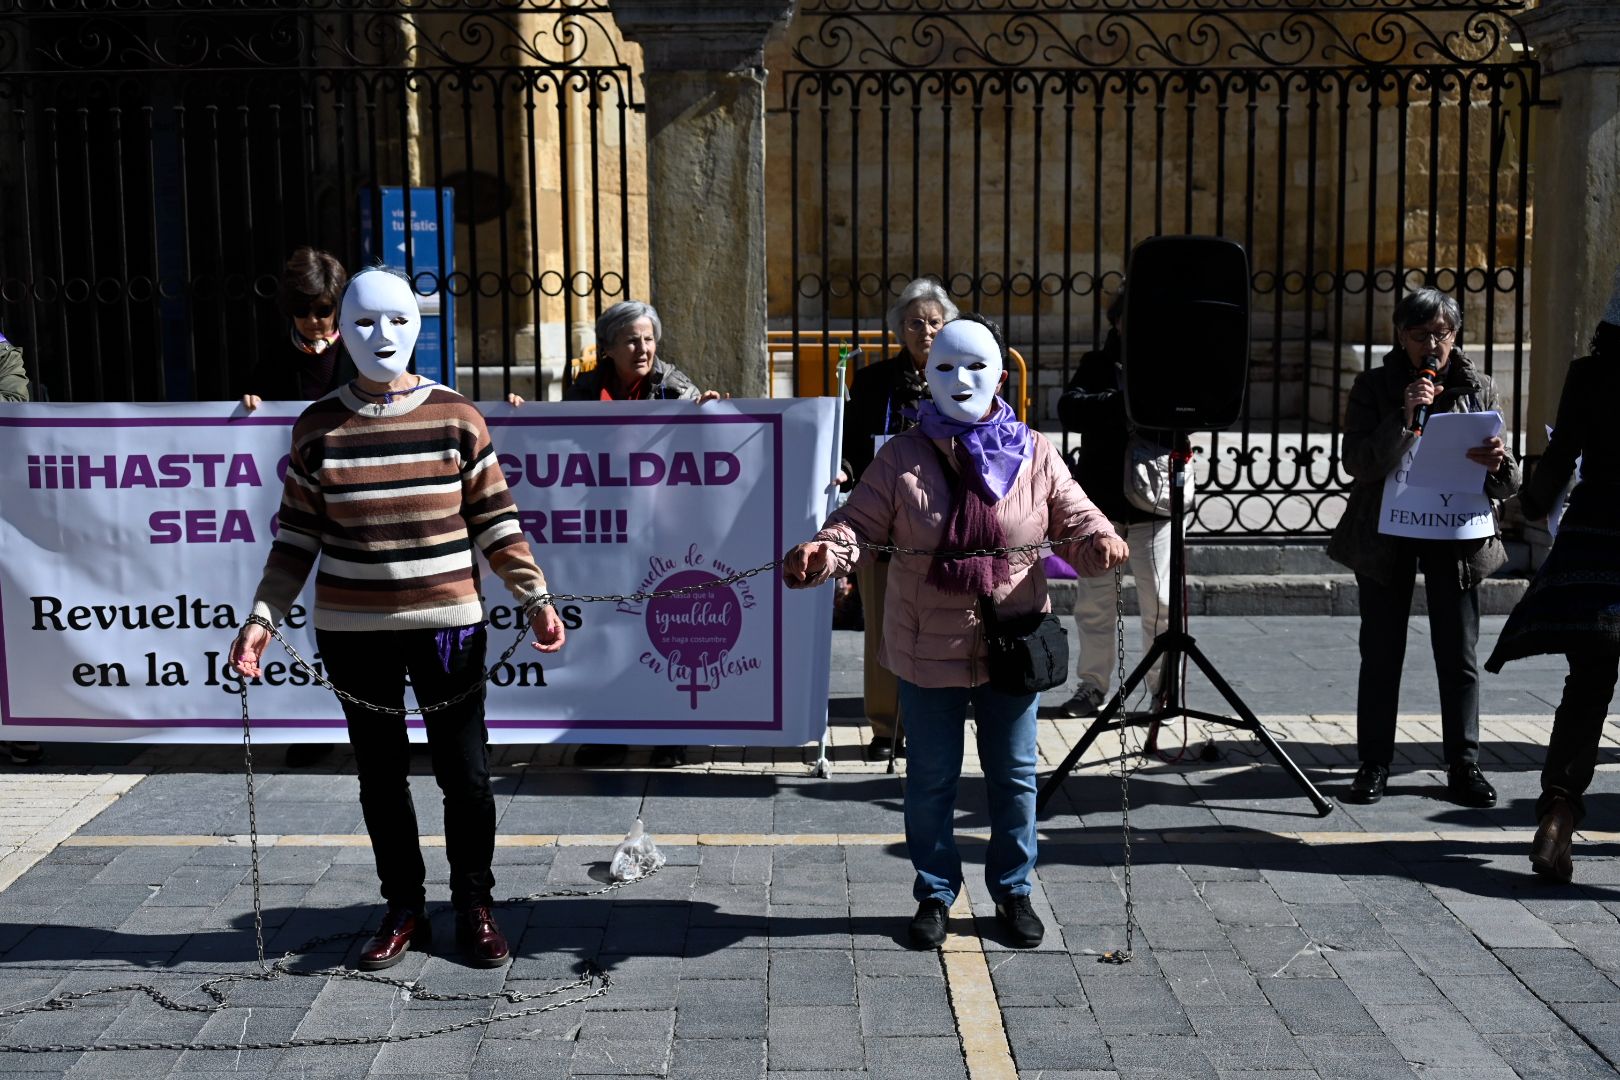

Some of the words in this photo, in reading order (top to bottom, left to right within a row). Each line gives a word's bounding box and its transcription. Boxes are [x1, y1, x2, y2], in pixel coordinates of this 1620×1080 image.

[27, 453, 263, 490] ¡¡¡HASTA
[497, 451, 741, 489] GUALDAD
[1440, 493, 1453, 507] Y
[148, 509, 256, 544] SEA
[1390, 509, 1488, 527] FEMINISTAS
[684, 542, 705, 567] de
[30, 594, 240, 631] Revuelta
[655, 601, 733, 634] igualdad
[72, 661, 130, 687] en
[145, 652, 189, 687] la
[639, 651, 664, 674] en
[668, 649, 691, 682] la
[700, 649, 761, 690] Iglesia
